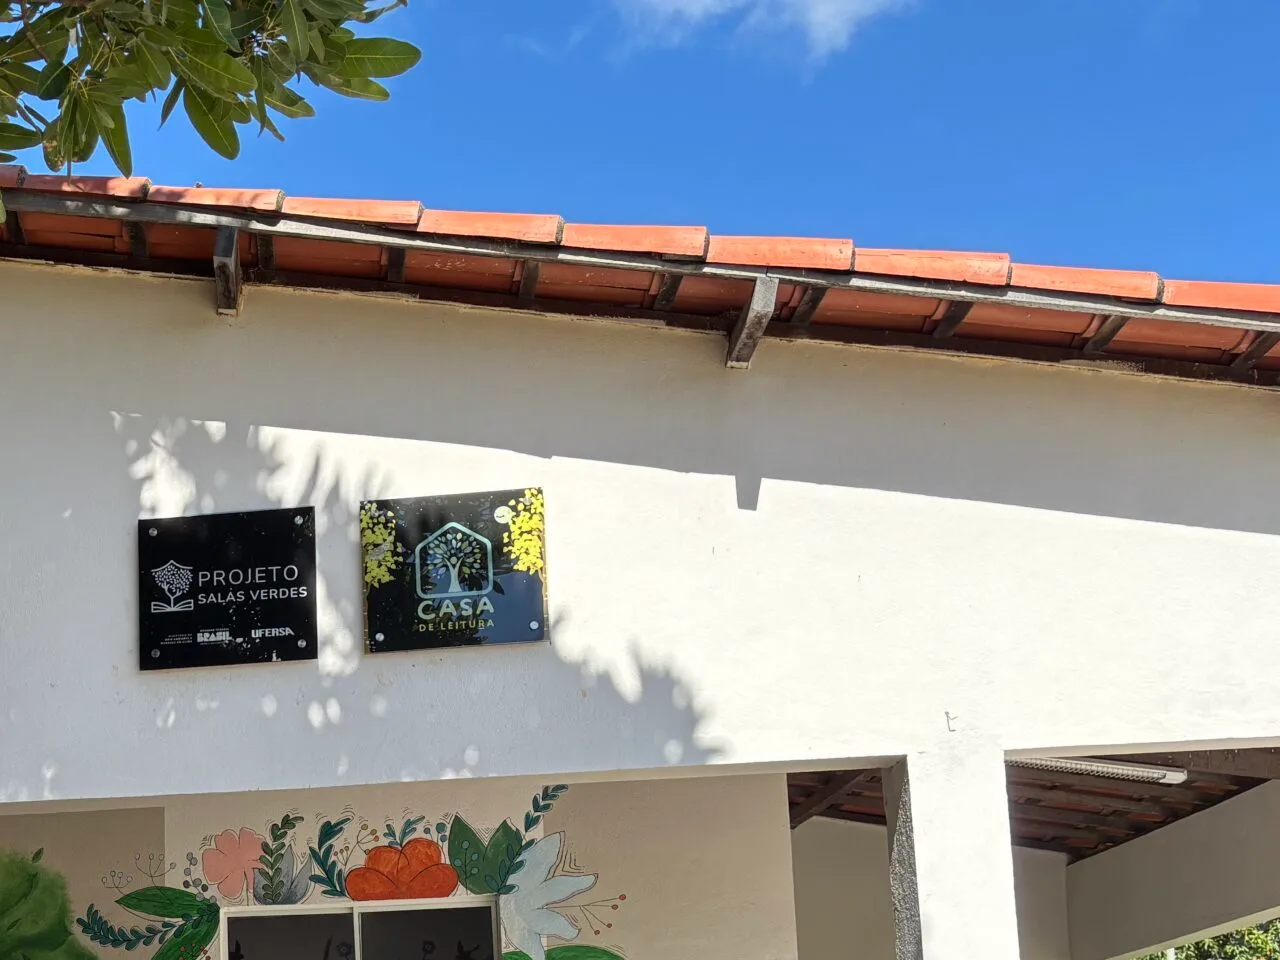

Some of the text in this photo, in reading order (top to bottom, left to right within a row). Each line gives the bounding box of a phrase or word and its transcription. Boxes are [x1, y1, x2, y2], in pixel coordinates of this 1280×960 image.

[199, 565, 298, 586] PROJETO
[198, 586, 308, 604] SALAS VERDES
[418, 597, 494, 619] CASA
[251, 627, 294, 638] UFERSA
[419, 619, 495, 632] DE LEITURA
[196, 631, 232, 643] BRASIL
